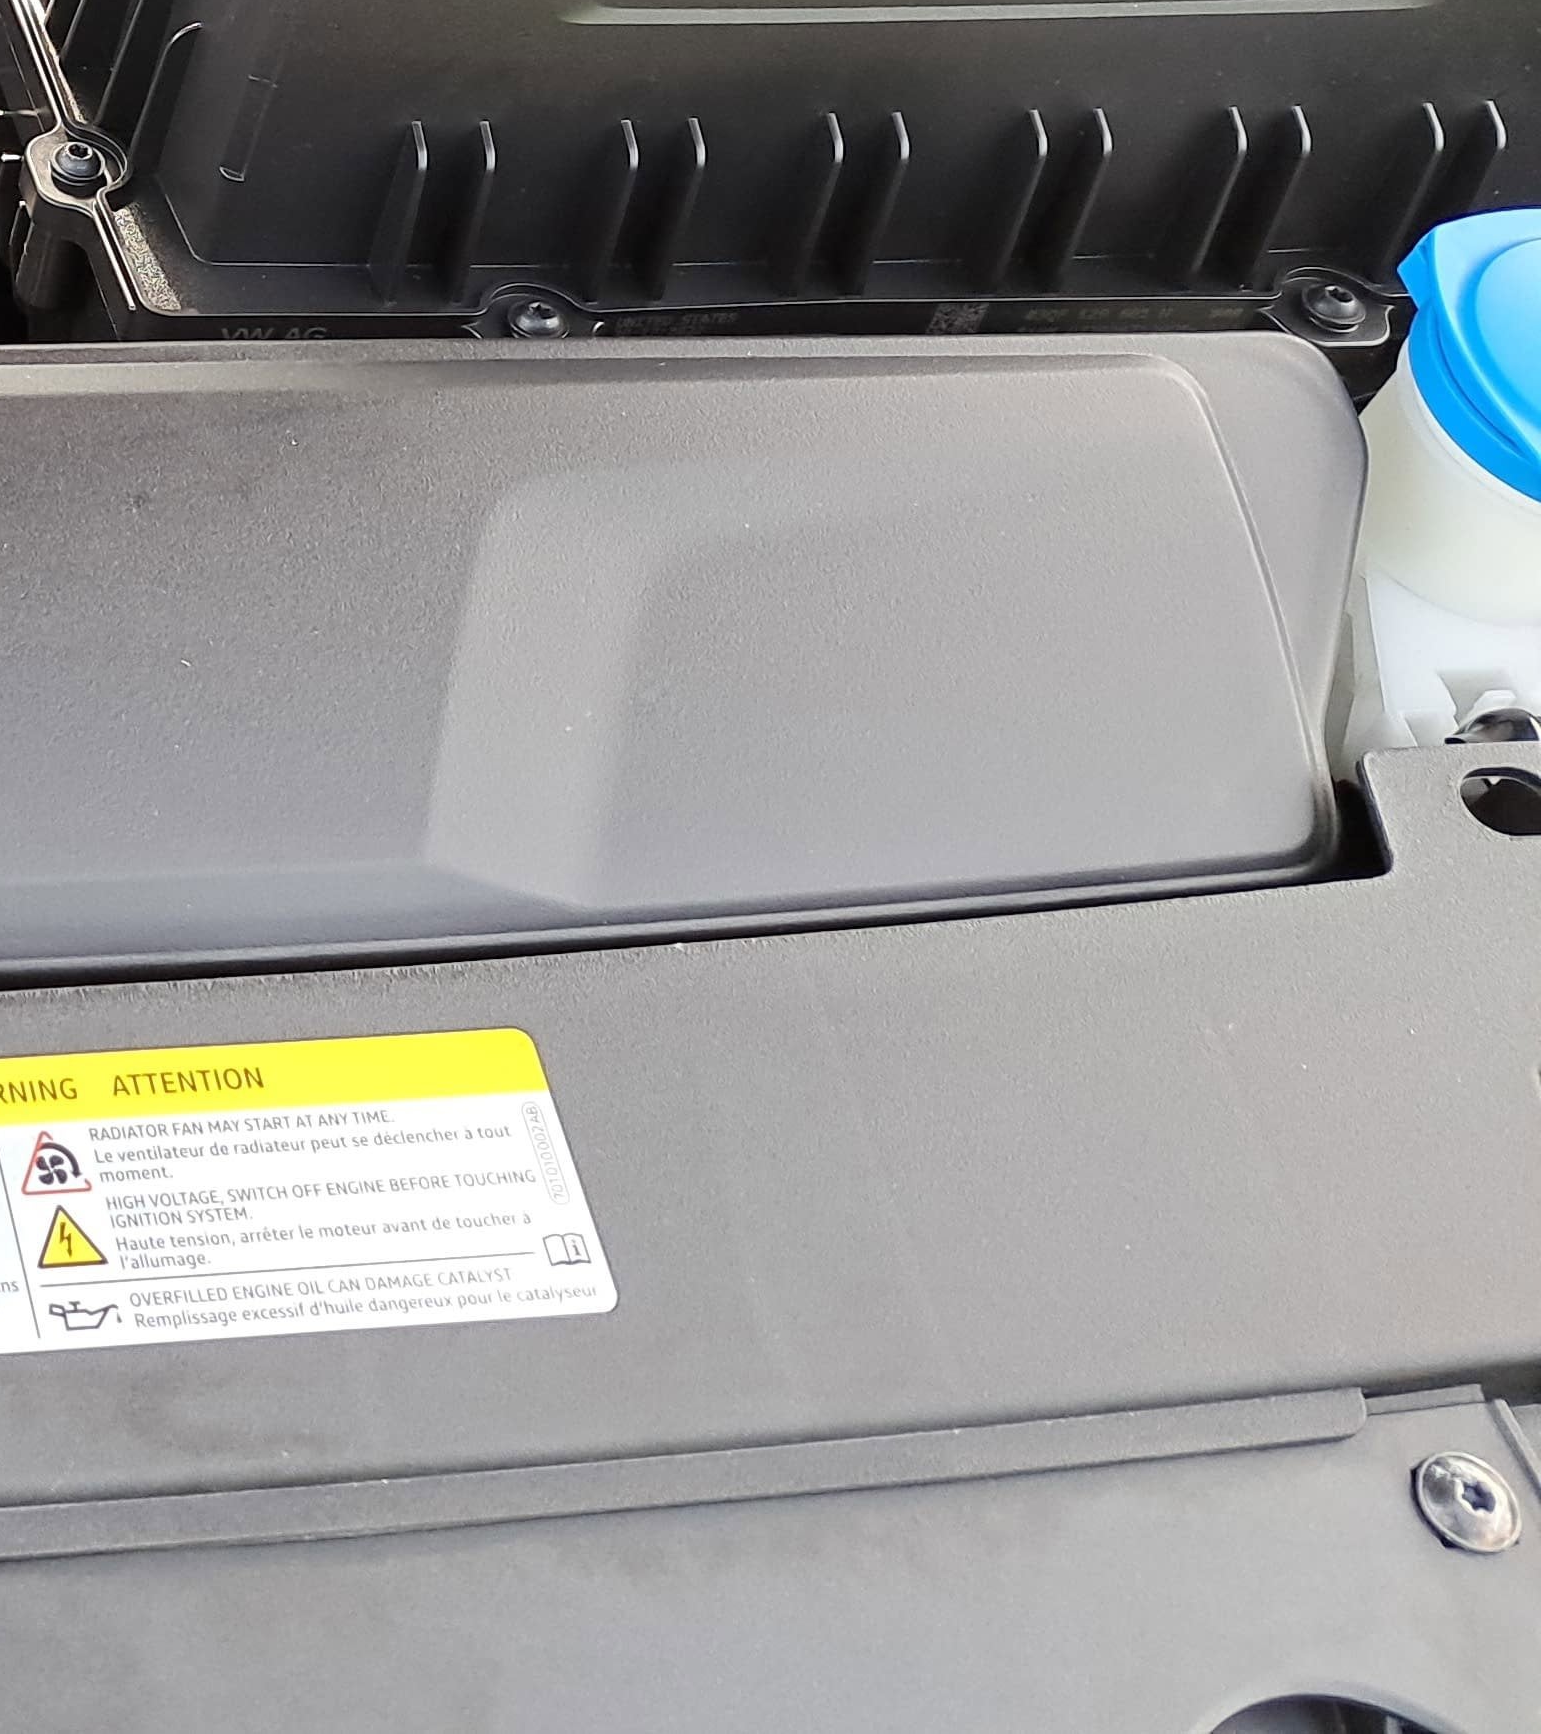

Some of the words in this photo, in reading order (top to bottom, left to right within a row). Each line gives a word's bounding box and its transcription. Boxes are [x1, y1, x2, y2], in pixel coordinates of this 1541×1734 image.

[112, 1066, 265, 1097] ATTENTION
[88, 1123, 170, 1142] RADIATOR
[171, 1121, 204, 1137] FAN
[207, 1119, 240, 1134] MAY
[243, 1115, 290, 1132] START
[296, 1113, 313, 1129] AT
[318, 1112, 348, 1127] ANY
[93, 1148, 114, 1164] Le
[116, 1145, 205, 1163] ventilateur
[209, 1141, 230, 1157] de
[232, 1139, 306, 1155] radiateur
[310, 1136, 348, 1154] peut
[351, 1135, 369, 1148] se
[476, 1125, 512, 1139] tout
[98, 1165, 174, 1183] moment.
[104, 1193, 146, 1211] HIGH
[147, 1189, 225, 1208] VOLTAGE,
[226, 1185, 289, 1203] SWITCH
[291, 1183, 322, 1199] OFF
[325, 1179, 387, 1197] ENGINE
[388, 1174, 452, 1193] BEFORE
[453, 1169, 537, 1187] TOUCHING
[109, 1209, 184, 1229] IGNITION
[114, 1235, 166, 1252] Haute
[168, 1233, 236, 1249] tension,
[297, 1223, 314, 1240] le
[318, 1223, 377, 1239] moteur
[382, 1218, 428, 1234] avant
[431, 1215, 452, 1231] de
[455, 1213, 516, 1229] toucher
[119, 1253, 212, 1271] l'allumage.
[129, 1286, 228, 1308] OVERFILLED
[231, 1282, 294, 1301] ENGINE
[296, 1280, 326, 1296] OIL
[327, 1278, 361, 1294] CAN
[364, 1273, 434, 1291] DAMAGE
[437, 1267, 512, 1286] CATALYST
[133, 1309, 238, 1329] Remplissage
[241, 1301, 305, 1321] excessif
[309, 1297, 364, 1317] d'huile
[368, 1296, 454, 1314] dangereux
[456, 1293, 493, 1310] pour
[496, 1289, 512, 1303] le
